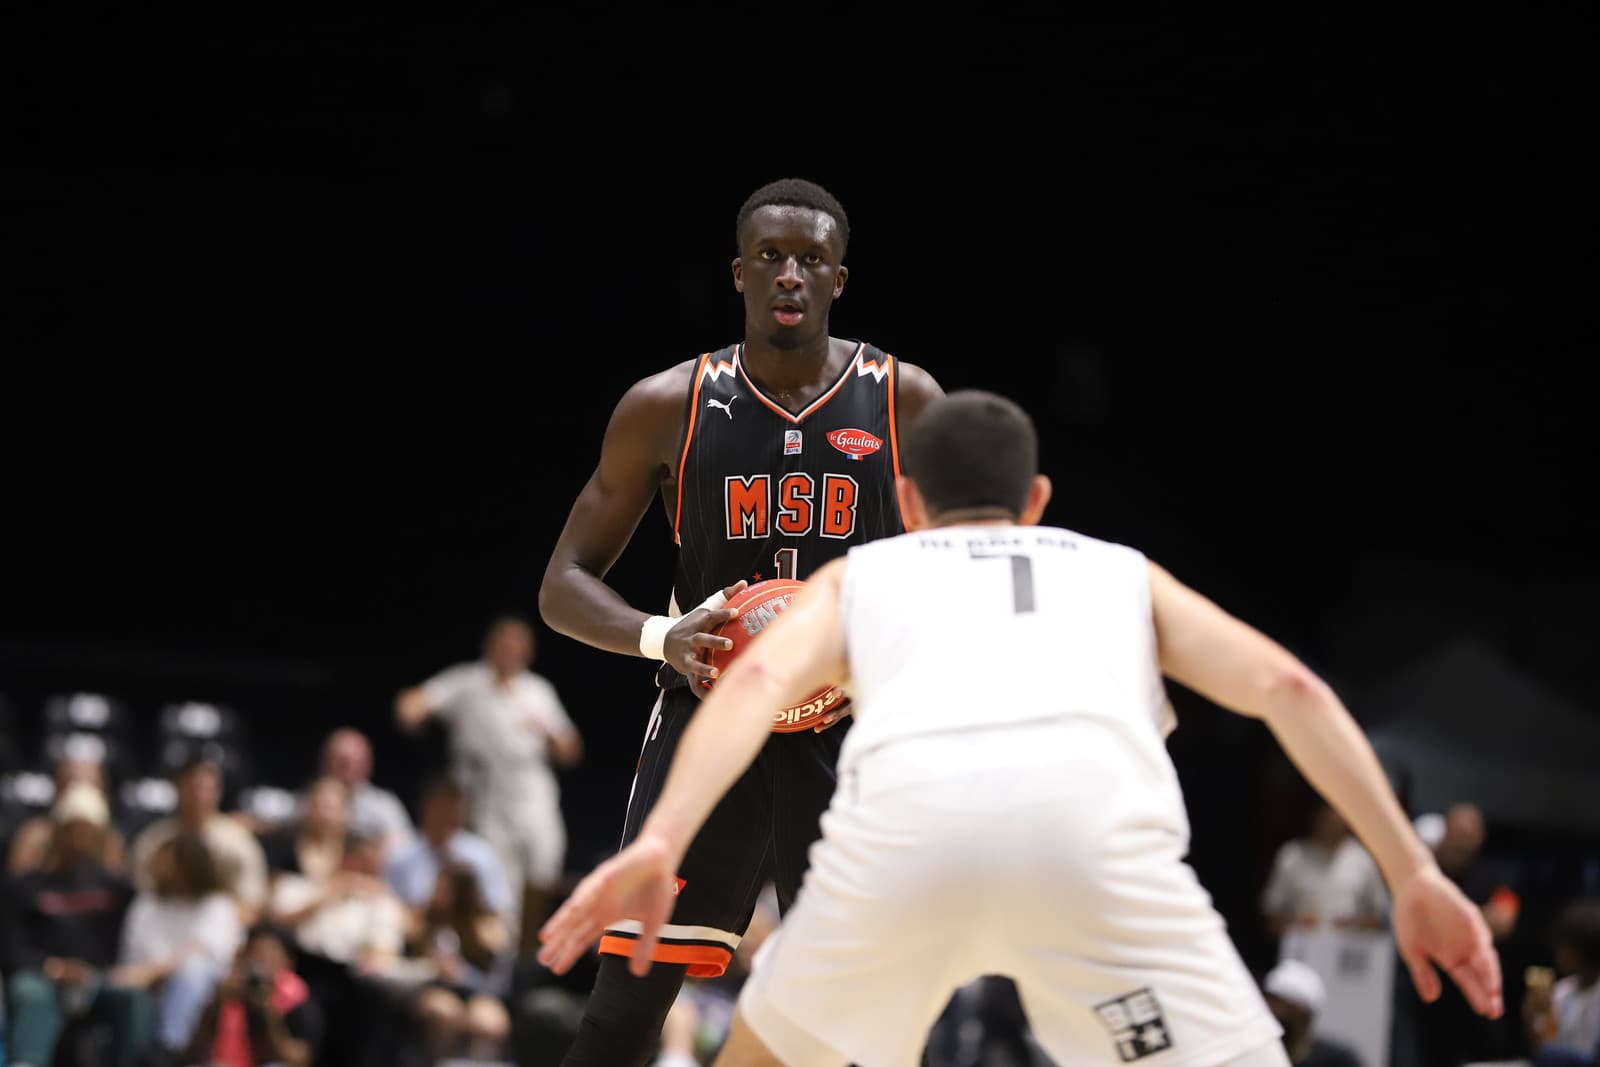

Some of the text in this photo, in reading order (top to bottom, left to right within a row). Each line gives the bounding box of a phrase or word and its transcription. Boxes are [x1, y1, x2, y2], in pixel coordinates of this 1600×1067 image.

[836, 431, 880, 450] Gaulois
[724, 471, 859, 540] MSB
[774, 548, 798, 580] 1
[773, 691, 836, 724] etclic
